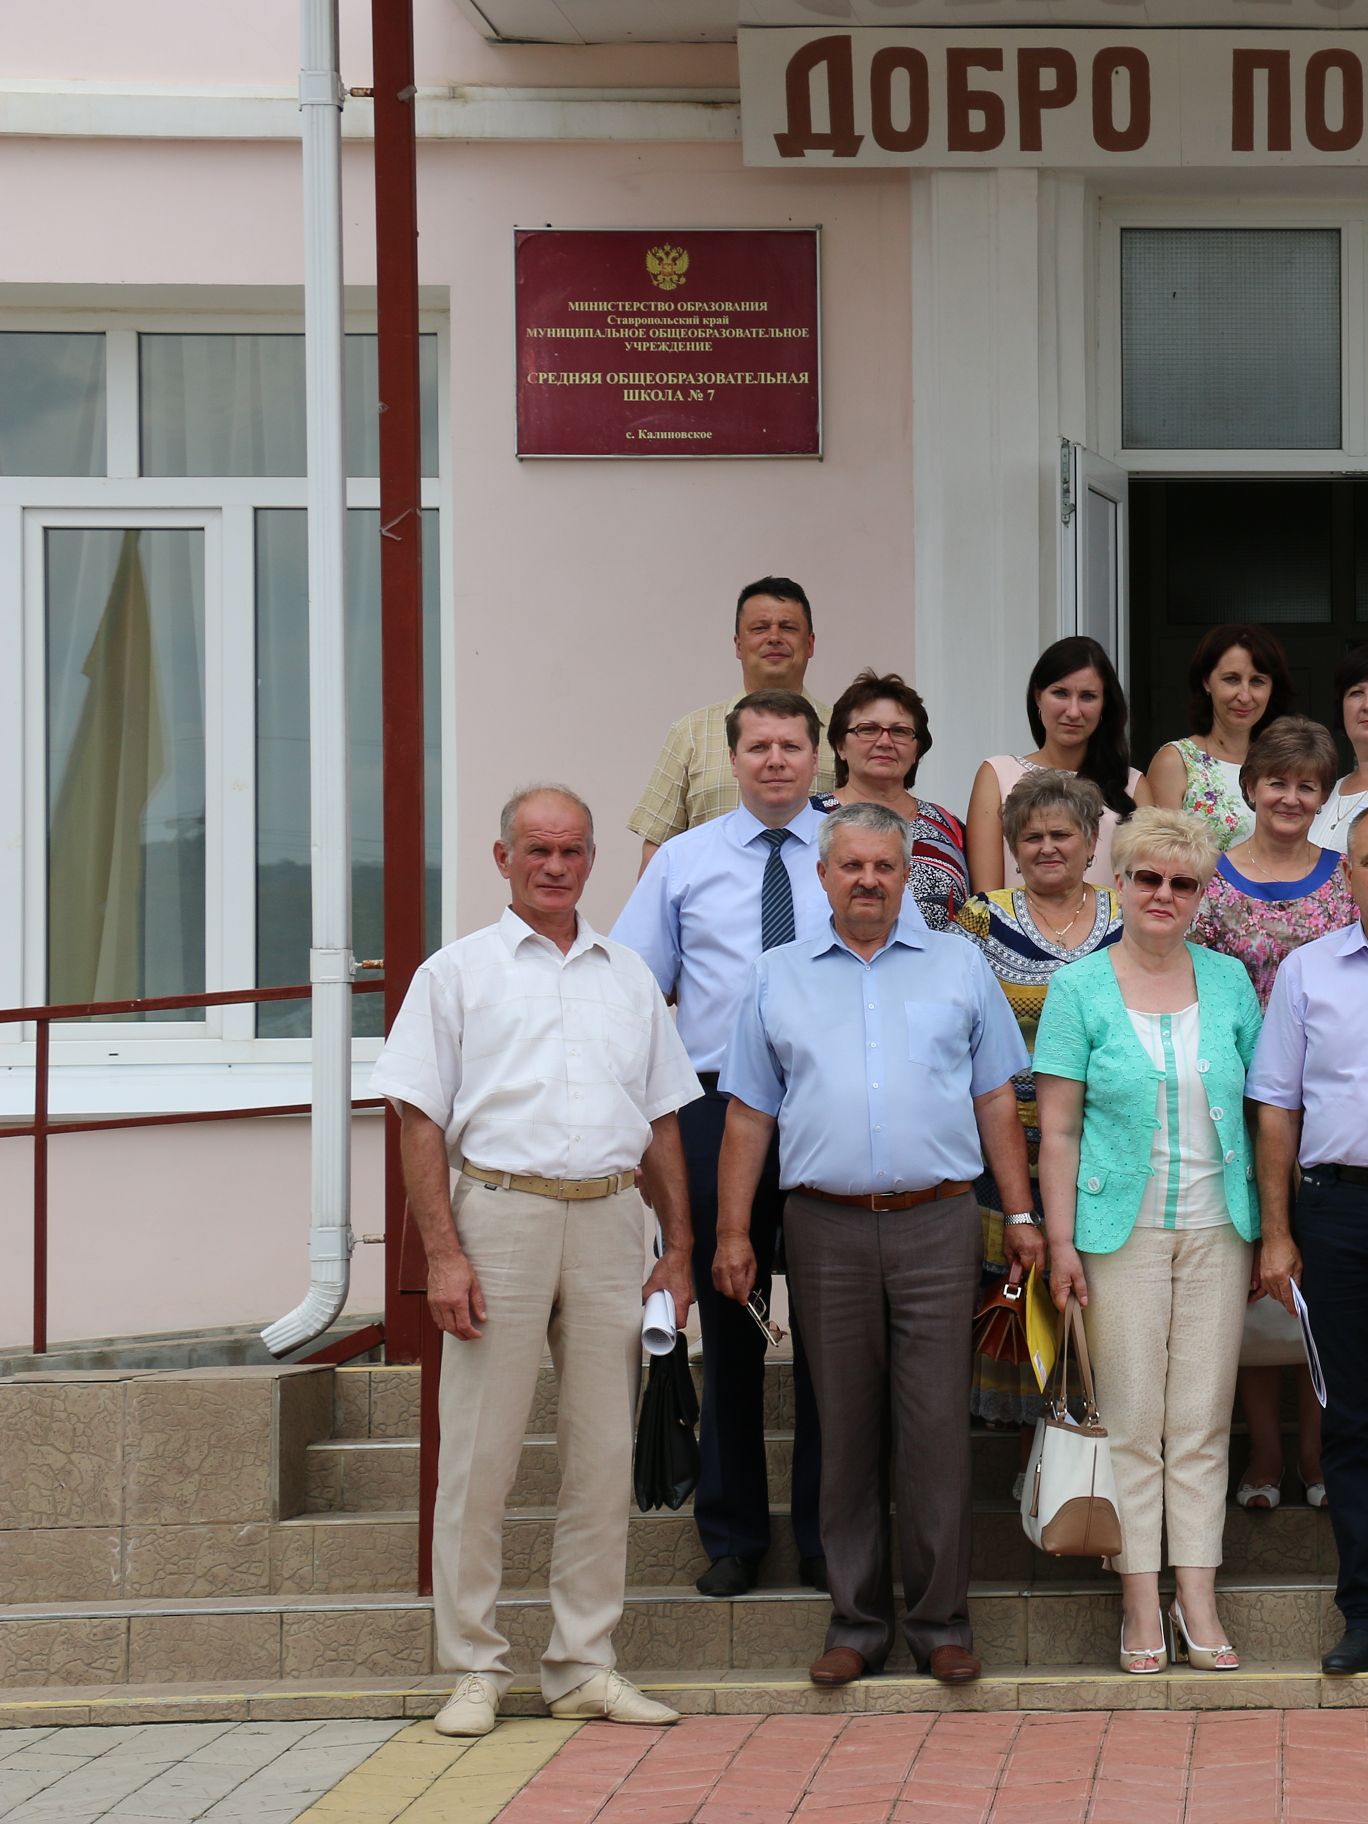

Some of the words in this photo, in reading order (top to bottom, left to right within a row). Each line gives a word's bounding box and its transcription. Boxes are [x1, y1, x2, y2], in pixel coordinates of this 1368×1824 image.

[774, 34, 1151, 158] ДОБРО
[568, 301, 674, 312] МИНИСТЕРСТВО
[677, 301, 768, 312] ОБРАЗОВАНИЯ
[607, 314, 700, 326] Ставропольский
[702, 315, 729, 326] край
[526, 328, 646, 339] МУНИЦИПАЛЬНОЕ
[649, 328, 809, 339] ОБЩЕОБРАЗОВАТЕЛЬНОЕ
[624, 341, 713, 353] УЧРЕЖДЕНИЕ
[527, 372, 602, 386] СРЕДНЯЯ
[606, 372, 809, 386] ОБЩЕОБРАЗОВАТЕЛЬНАЯ
[623, 389, 684, 401] ШКОЛА
[707, 389, 715, 401] 7
[625, 430, 635, 439] с.
[638, 429, 713, 440] Калиновское
